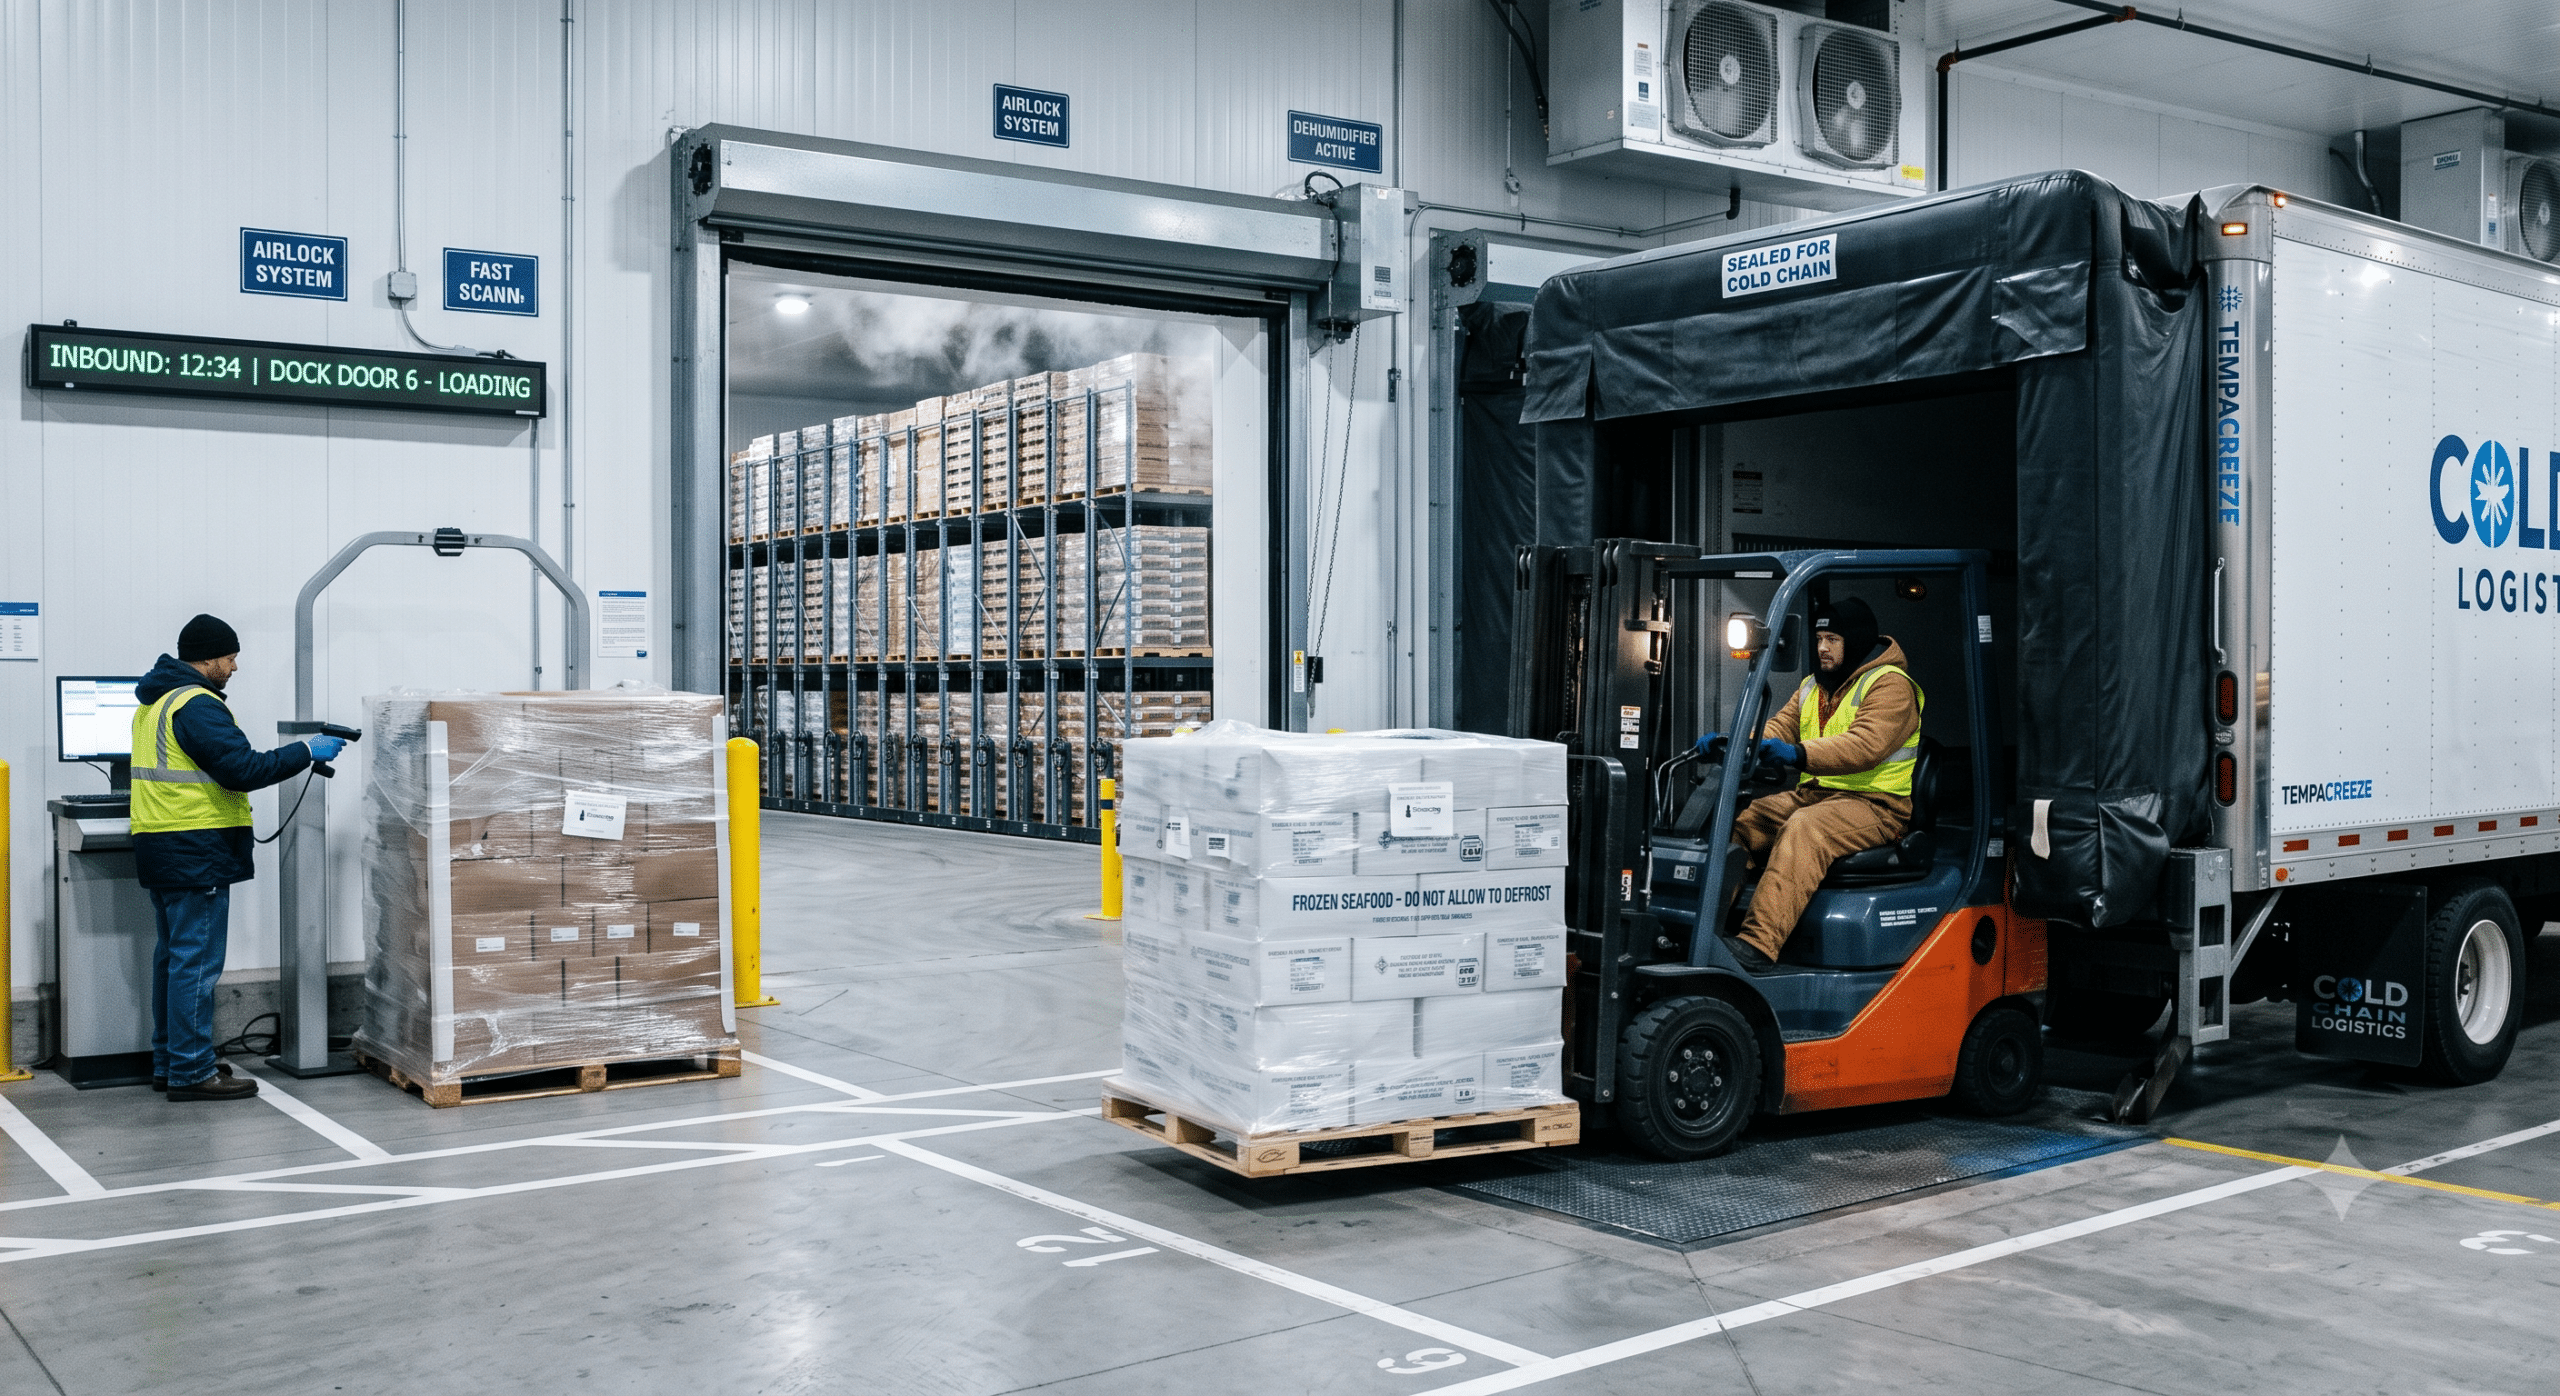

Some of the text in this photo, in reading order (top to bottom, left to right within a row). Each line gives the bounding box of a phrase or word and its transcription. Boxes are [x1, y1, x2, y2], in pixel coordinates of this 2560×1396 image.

[1002, 95, 1061, 118] AIRLOCK
[1003, 115, 1059, 137] SYSTEM
[1315, 142, 1356, 161] ACTIVE
[252, 240, 335, 265] AIRLOCK
[1727, 239, 1831, 273] SEALED FOR
[255, 264, 332, 288] SYSTEM
[470, 261, 514, 281] FAST
[1727, 259, 1831, 293] COLD CHAIN
[50, 344, 170, 375] INBOUND:
[179, 353, 241, 379] 12:34
[270, 359, 331, 386] DOCK
[338, 364, 400, 389] DOOR
[405, 369, 418, 391] 6
[439, 371, 531, 399] LOADING
[2217, 320, 2240, 527] TEMPACREEZE
[2281, 779, 2373, 805] TEMPACREEZE
[1292, 894, 1339, 911] FROZEN
[1341, 892, 1394, 910] SEAFOOD
[1404, 890, 1420, 908] DO
[1422, 889, 1446, 906] NOT
[1447, 888, 1486, 906] ALLOW
[1488, 887, 1502, 904] TO
[1504, 885, 1552, 903] DEFROST
[2313, 974, 2409, 1007] COLD
[2312, 1002, 2406, 1025] CHAIN
[2311, 1015, 2406, 1040] LOGISTICS
